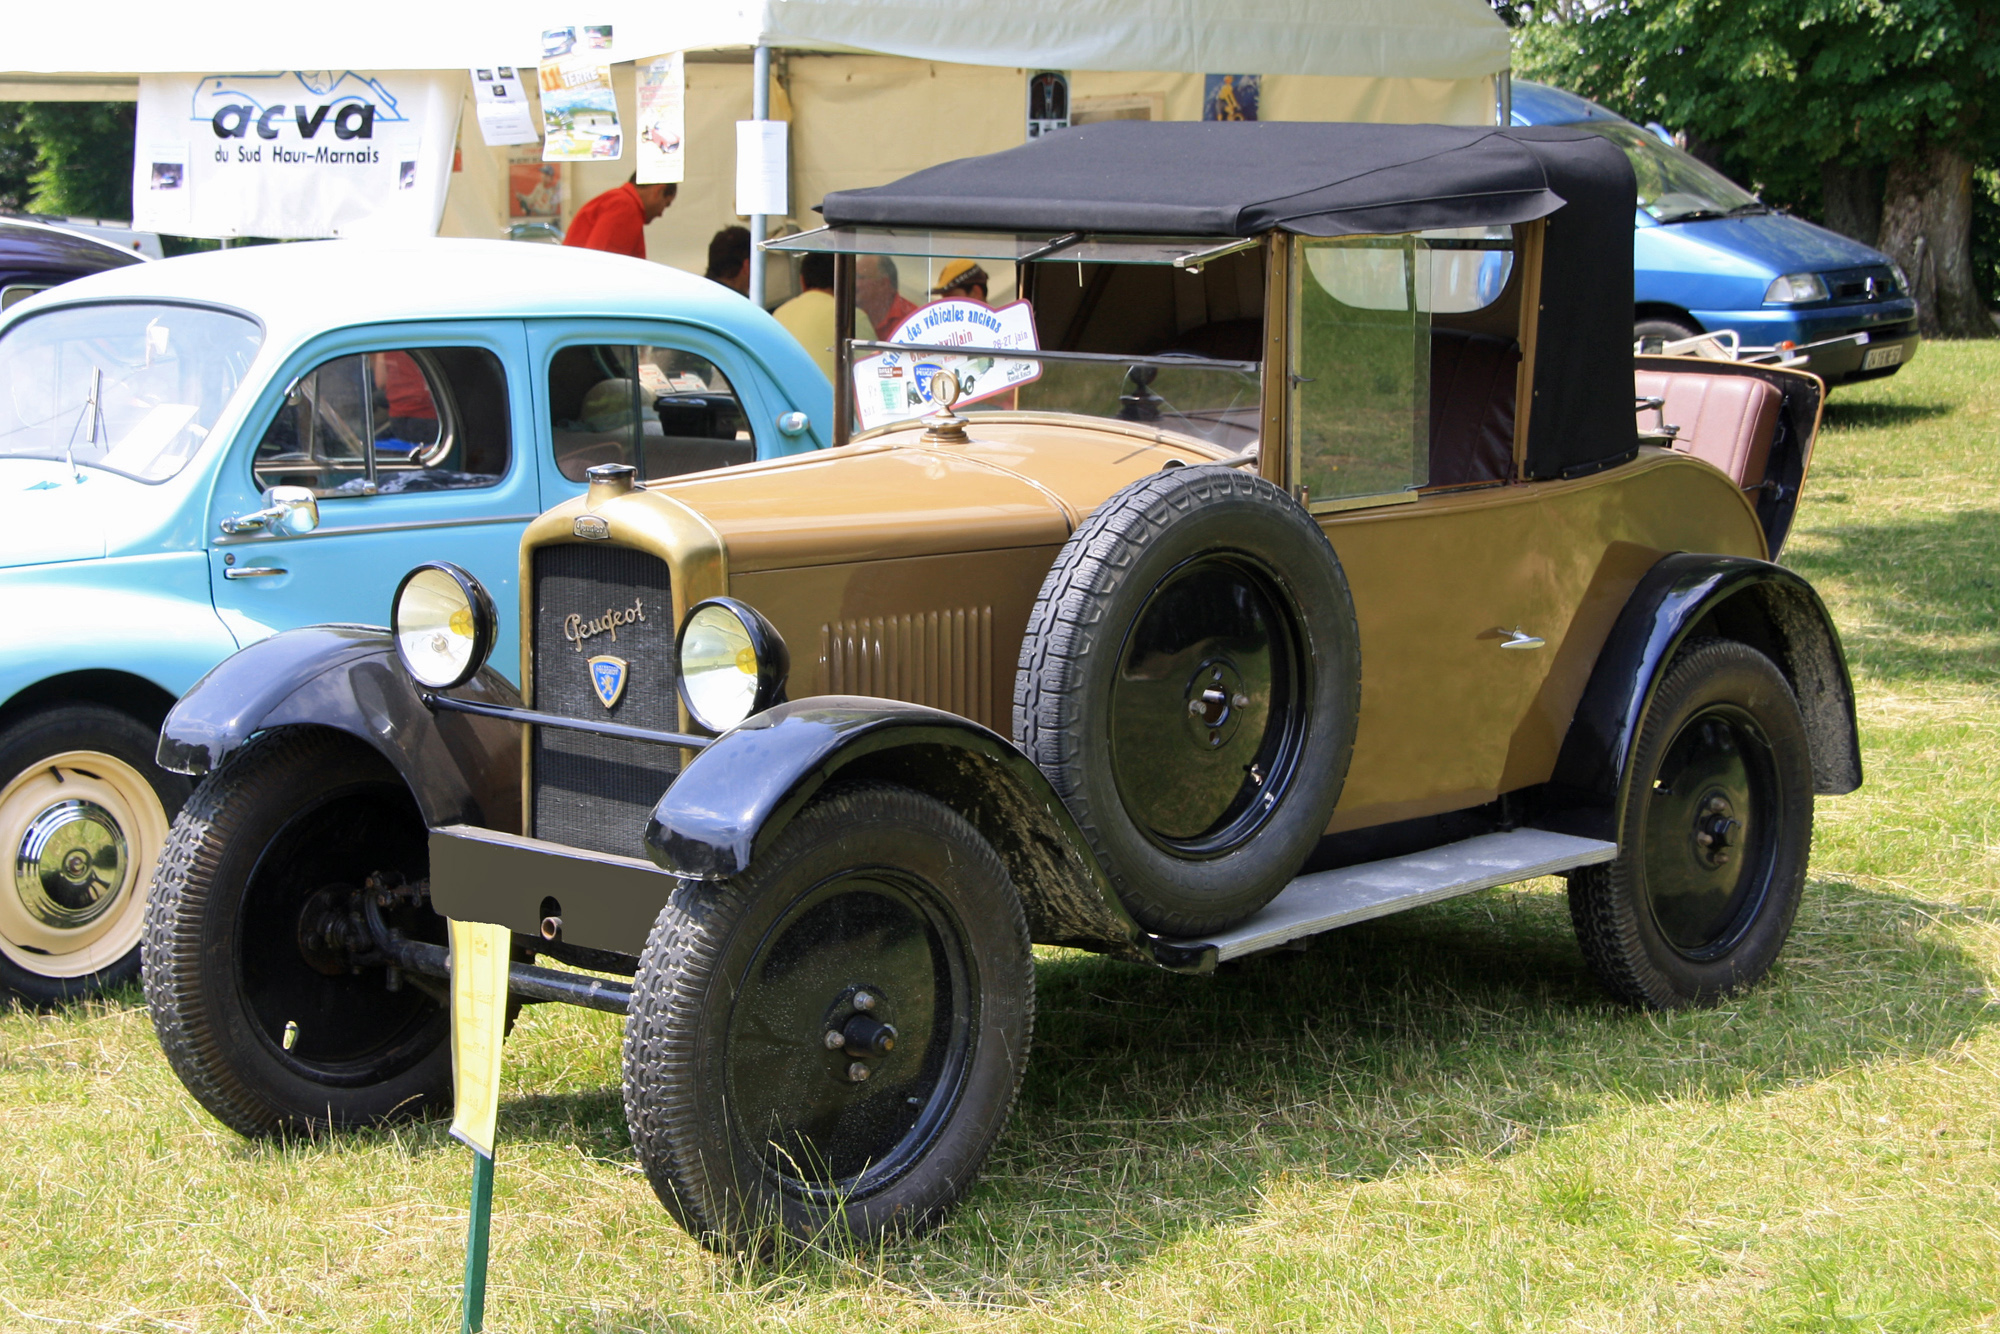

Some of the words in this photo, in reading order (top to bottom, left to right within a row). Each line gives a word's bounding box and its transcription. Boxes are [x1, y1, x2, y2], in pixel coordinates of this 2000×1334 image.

[561, 70, 599, 88] TERRE
[212, 104, 376, 140] acva
[214, 145, 229, 163] du
[238, 145, 262, 163] Sud
[906, 322, 922, 339] des
[967, 307, 1003, 334] anciens
[564, 597, 646, 652] Peugeot
